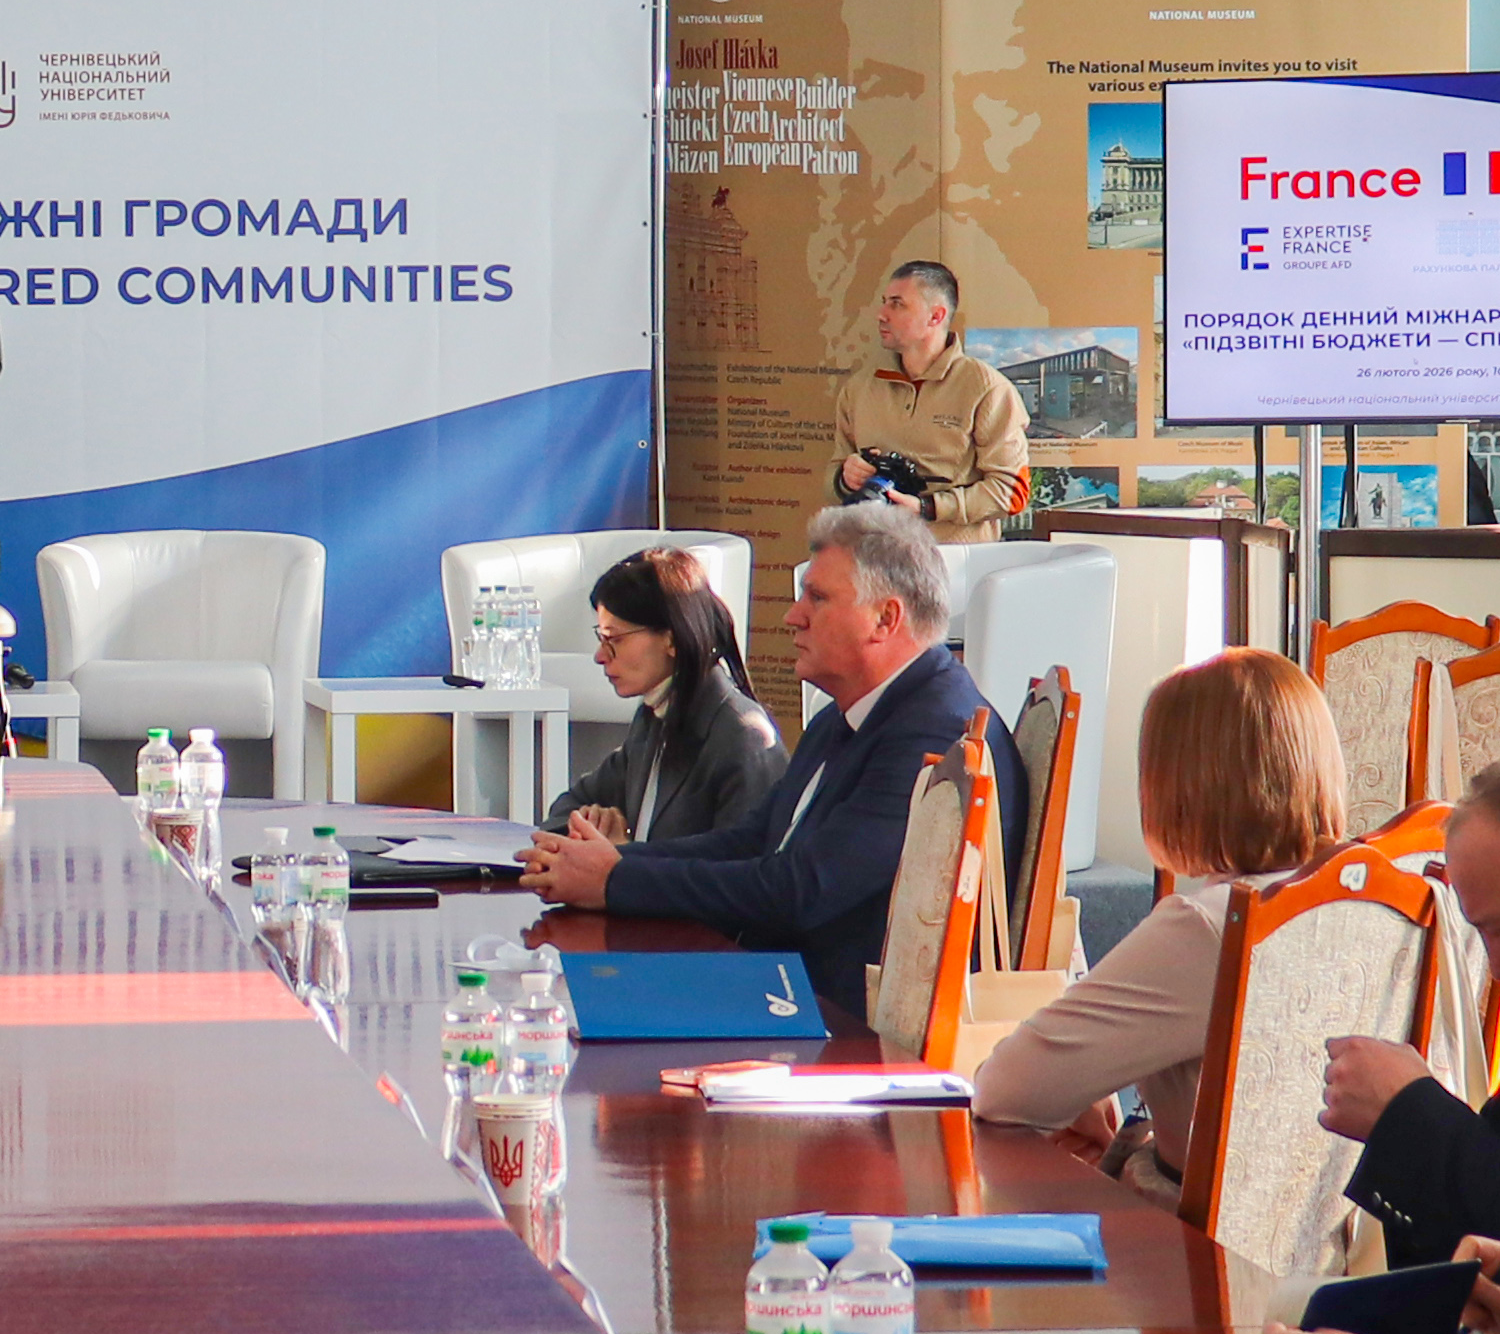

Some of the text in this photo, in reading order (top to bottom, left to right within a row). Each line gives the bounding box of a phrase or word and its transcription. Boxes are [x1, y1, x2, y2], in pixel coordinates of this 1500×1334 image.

[678, 14, 763, 24] NATIONAL MUSEUM
[1149, 10, 1255, 20] NATIONAL MUSEUM
[39, 51, 161, 67] ЧЕРНІВЕЦЬКИЙ
[676, 38, 719, 69] Josef
[1047, 59, 1358, 75] The National Museum invites you to visit
[39, 69, 171, 86] НАЦІОНАЛЬНИЙ
[722, 70, 857, 110] Viennese Builder
[1088, 80, 1145, 92] various
[40, 88, 145, 102] УНІВЕРСИТЕТ
[39, 111, 171, 122] ІМЕНІ ЮРІЯ ФЕДЬКОВИЧА
[723, 102, 845, 142] Czech Architect
[724, 134, 858, 174] European Patron
[1240, 156, 1421, 200] France
[125, 198, 408, 242] ГРОМАДИ
[1283, 224, 1372, 240] EXPERTISE
[1283, 240, 1351, 254] FRANCE
[1283, 260, 1352, 270] GROUPE AFD
[1413, 264, 1478, 273] РАХУНКОВА
[118, 264, 514, 305] COMMUNITIES
[1184, 312, 1295, 330] ПОРЯДОК
[1301, 307, 1398, 328] ДЕННИЙ
[1183, 335, 1304, 353] «ПІДЗВІТНІ
[1312, 333, 1431, 351] БЮДЖЕТИ
[750, 376, 781, 385] Republic
[1356, 368, 1372, 378] 26
[1374, 369, 1420, 378] лютого
[1423, 367, 1453, 377] 2026
[1456, 368, 1489, 378] року,
[1257, 395, 1345, 406] Чернівецький
[1348, 394, 1439, 405] національний
